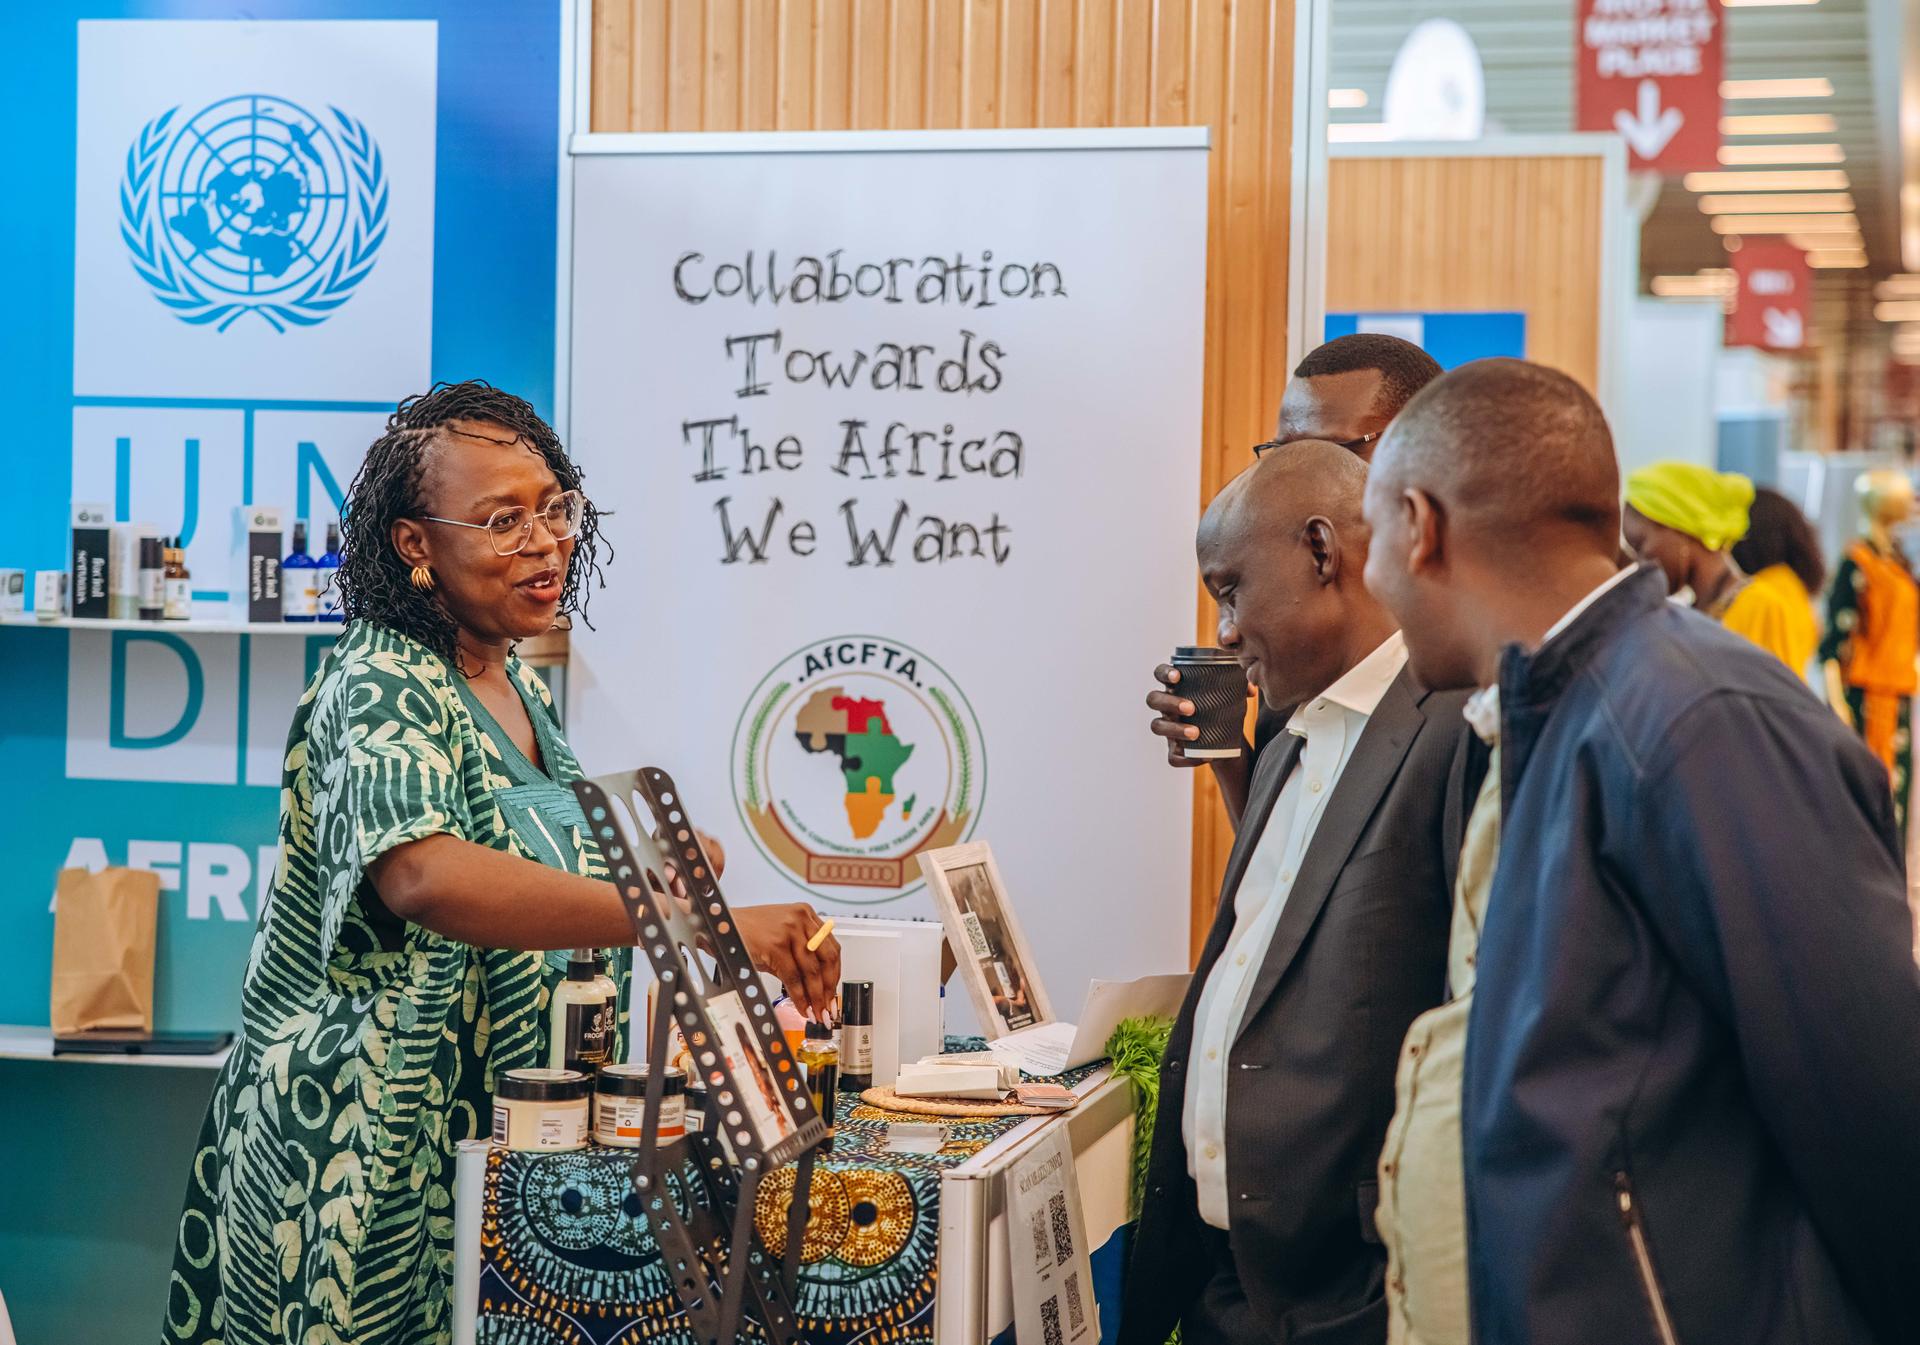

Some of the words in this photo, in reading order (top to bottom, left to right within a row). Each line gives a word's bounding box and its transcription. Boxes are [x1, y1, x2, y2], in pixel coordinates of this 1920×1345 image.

[673, 249, 1068, 308] Collaboration
[725, 328, 1007, 398] Towards
[682, 414, 803, 483] The
[830, 415, 1026, 481] Africa
[713, 496, 817, 565] We
[839, 498, 1012, 567] Want
[803, 643, 918, 682] AfCFTA
